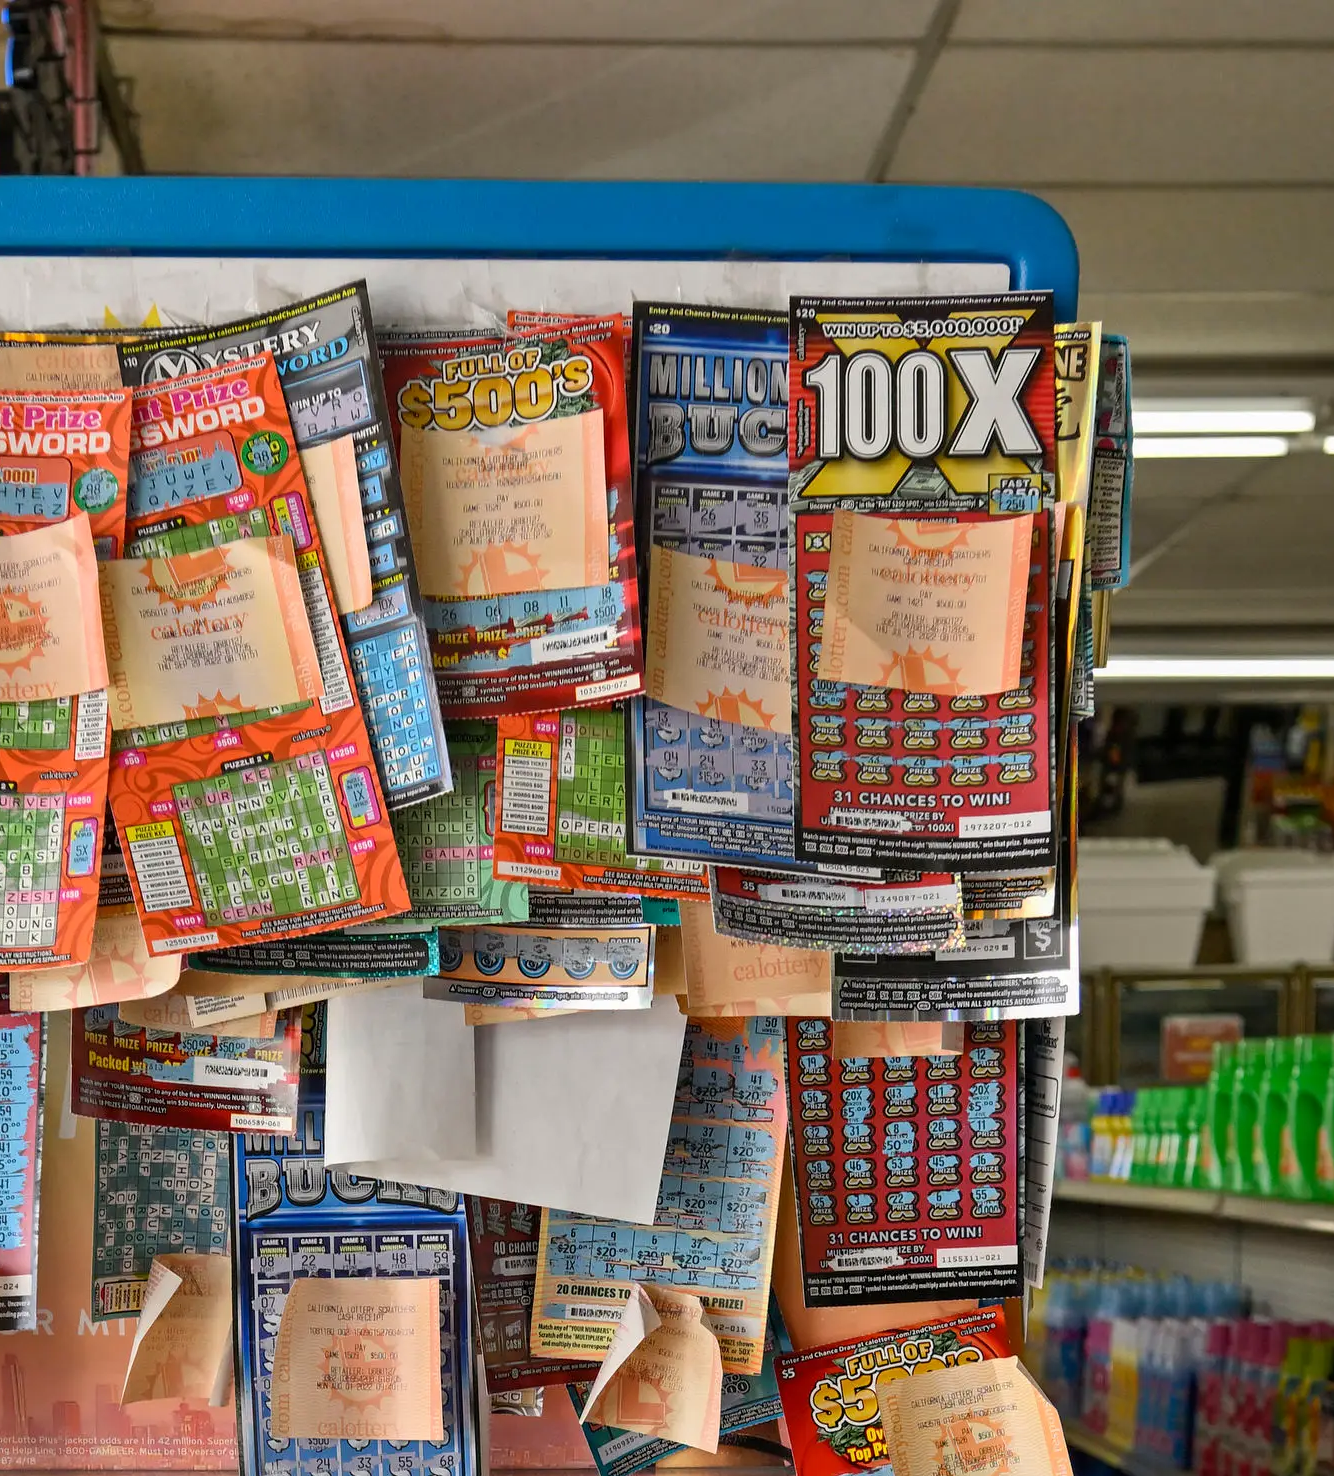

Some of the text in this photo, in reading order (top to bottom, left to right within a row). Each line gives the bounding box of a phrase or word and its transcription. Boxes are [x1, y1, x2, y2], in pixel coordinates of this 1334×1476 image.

[822, 323, 860, 337] WIN
[859, 322, 880, 337] UP
[879, 323, 904, 337] TO
[803, 348, 1043, 459] 100X
[23, 405, 102, 430] Prize
[833, 791, 1011, 807] 31 CHANCES TO WIN!
